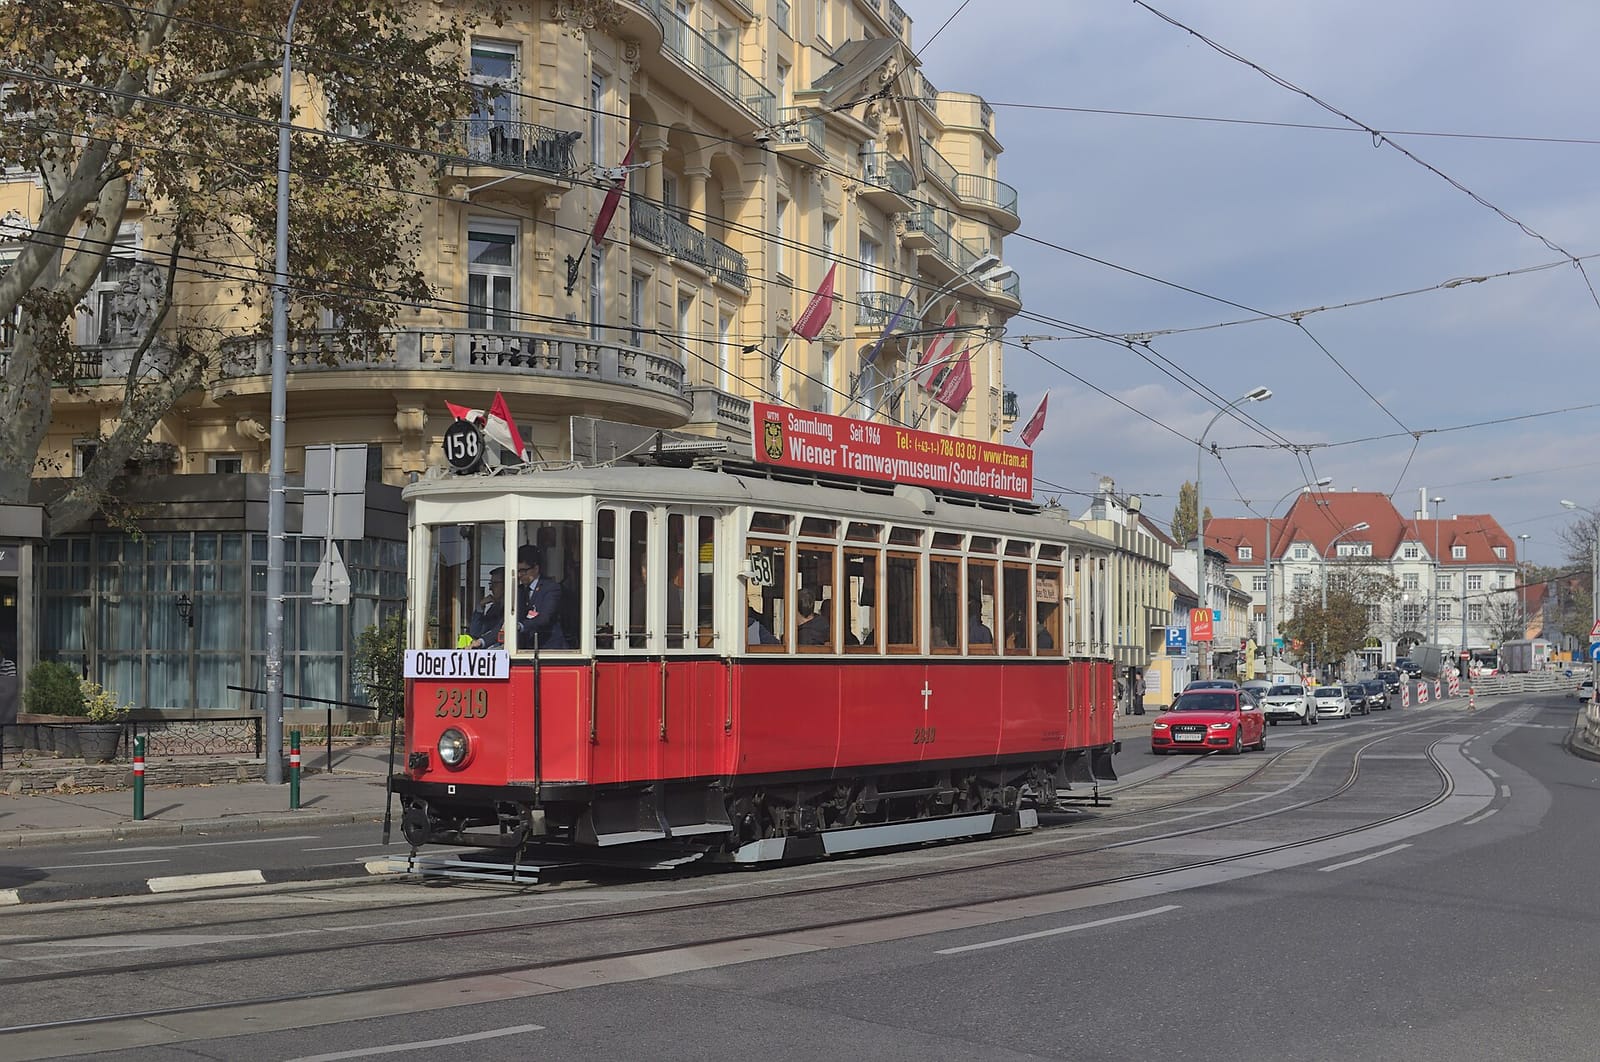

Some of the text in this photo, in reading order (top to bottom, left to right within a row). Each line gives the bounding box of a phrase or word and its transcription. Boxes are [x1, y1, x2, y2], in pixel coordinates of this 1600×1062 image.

[447, 432, 478, 460] 158
[788, 413, 833, 442] Sammlung
[849, 423, 864, 443] Seit
[865, 426, 881, 445] 1966
[896, 431, 912, 449] Tel:
[940, 439, 954, 457] 786
[955, 441, 965, 459] 03
[966, 443, 977, 460] 03
[984, 449, 1028, 469] www.tram.at
[788, 436, 1027, 493] Wiener Tramwaymuseum/Sonderfahrten
[1169, 629, 1180, 641] P
[416, 652, 446, 675] Ober
[435, 687, 488, 719] 2319
